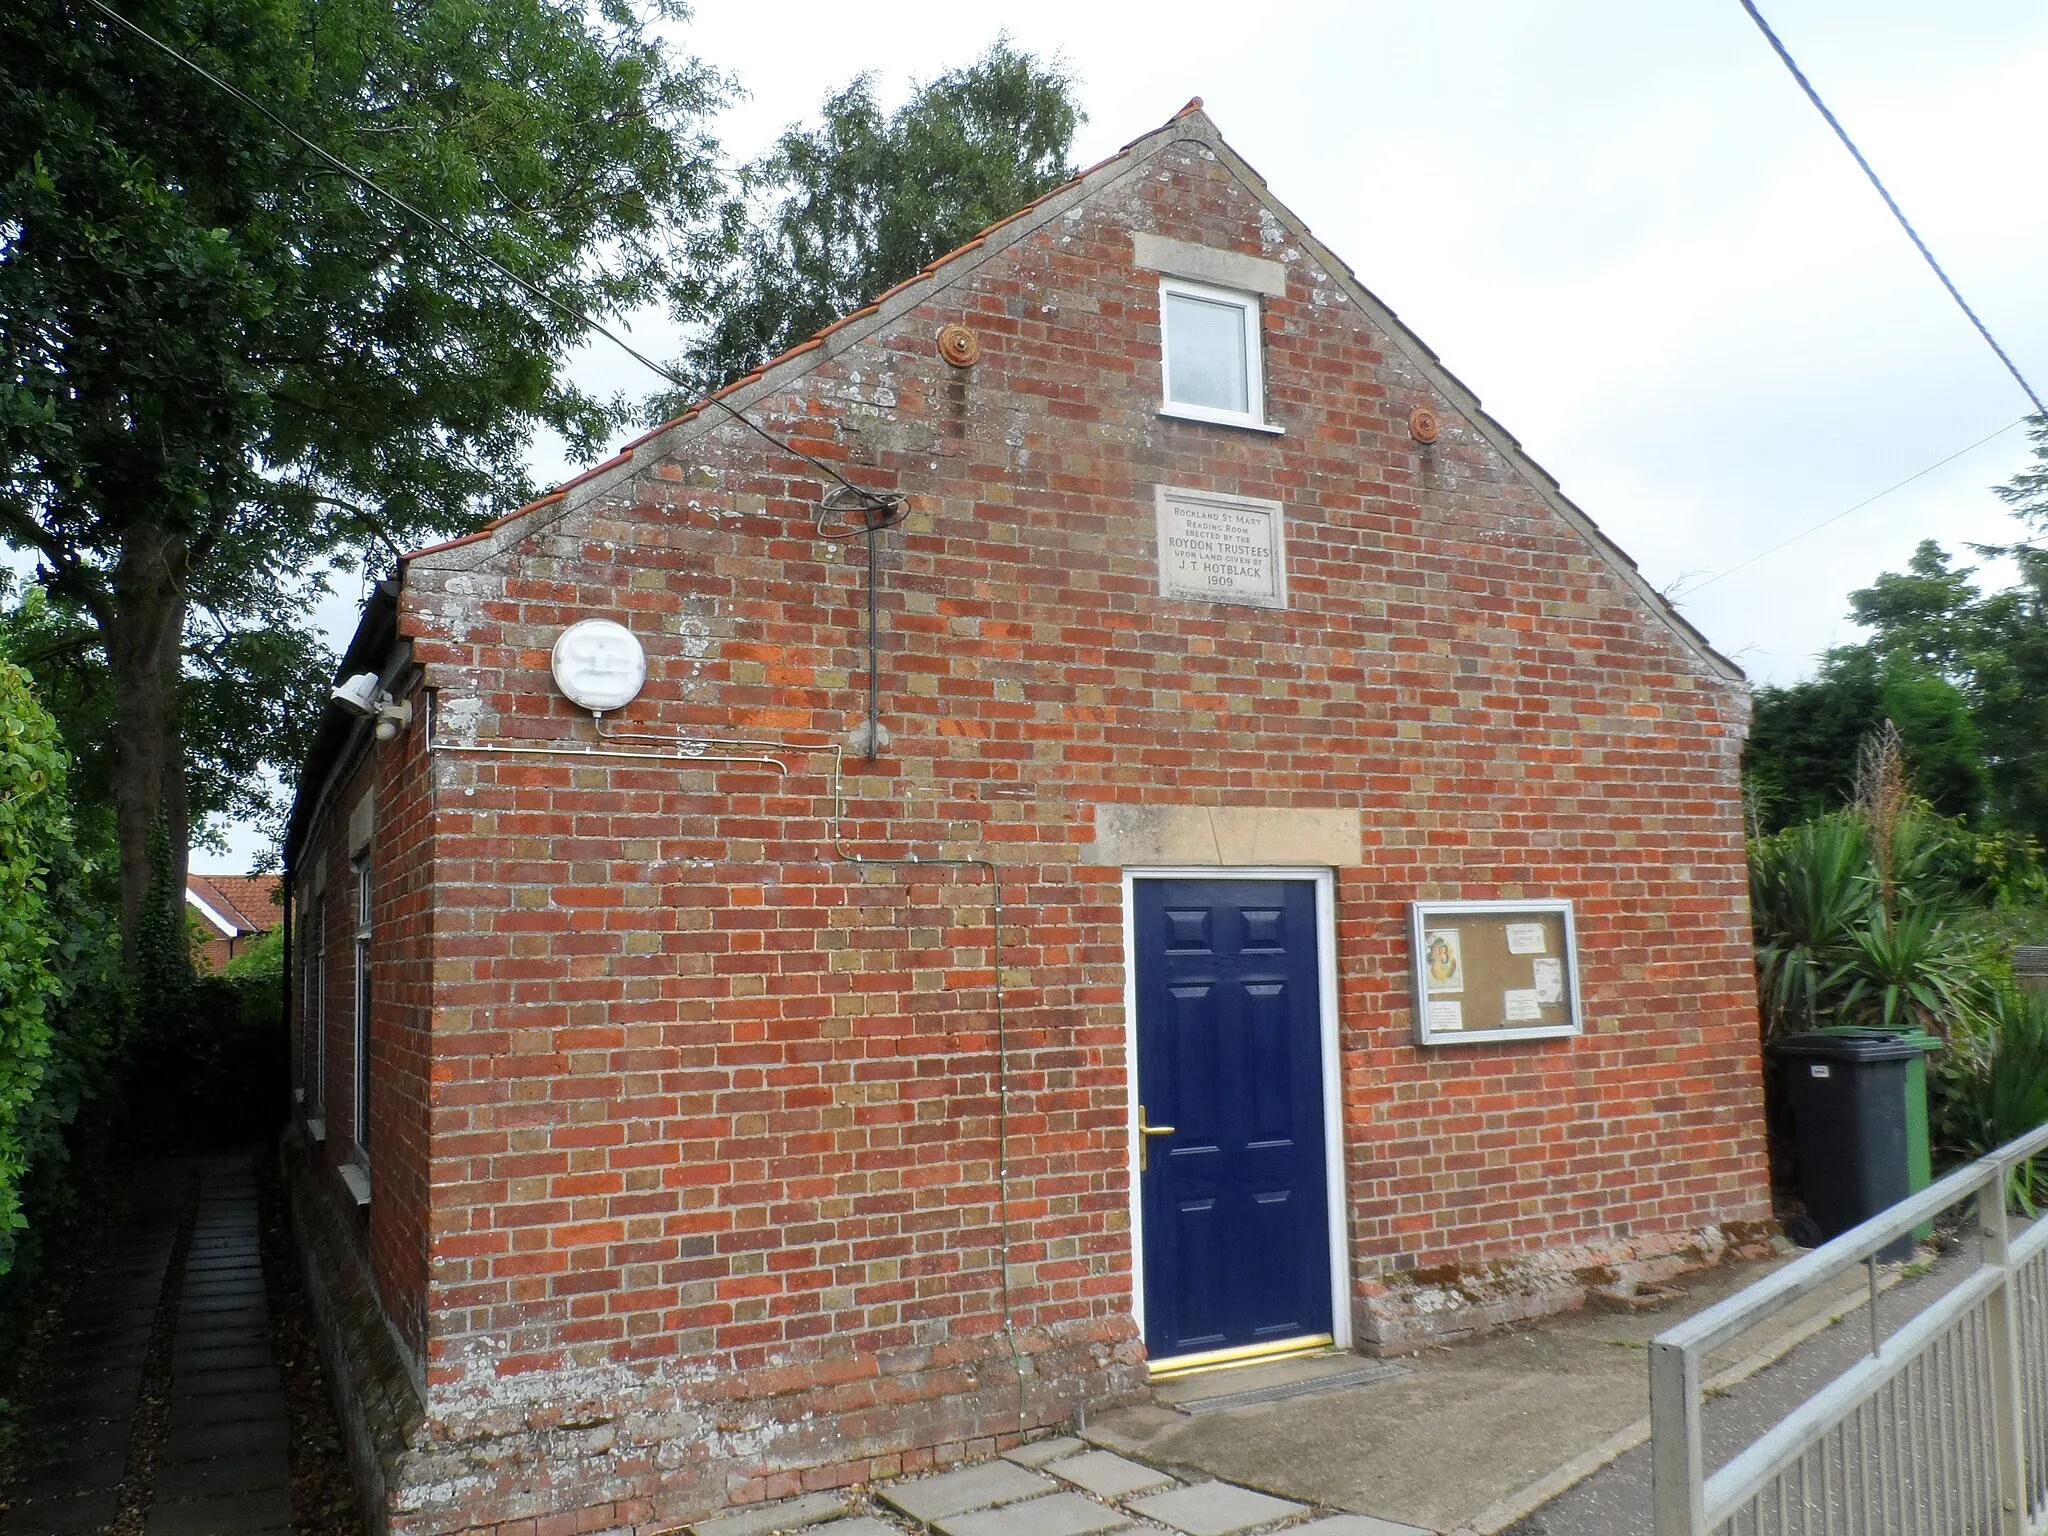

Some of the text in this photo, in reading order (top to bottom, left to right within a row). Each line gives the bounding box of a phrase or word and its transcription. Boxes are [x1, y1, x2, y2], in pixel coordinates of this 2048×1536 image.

[1174, 508, 1218, 520] ROCKLAND
[1236, 516, 1261, 525] MARY
[1187, 520, 1248, 534] READING ROOM
[1186, 530, 1220, 539] ERECTED
[1169, 537, 1269, 557] ROYDON TRUSTEES
[1200, 553, 1222, 561] LAND
[1226, 556, 1249, 564] GIVEN
[1204, 563, 1261, 577] HOTBLACK
[1208, 576, 1233, 586] 1909
